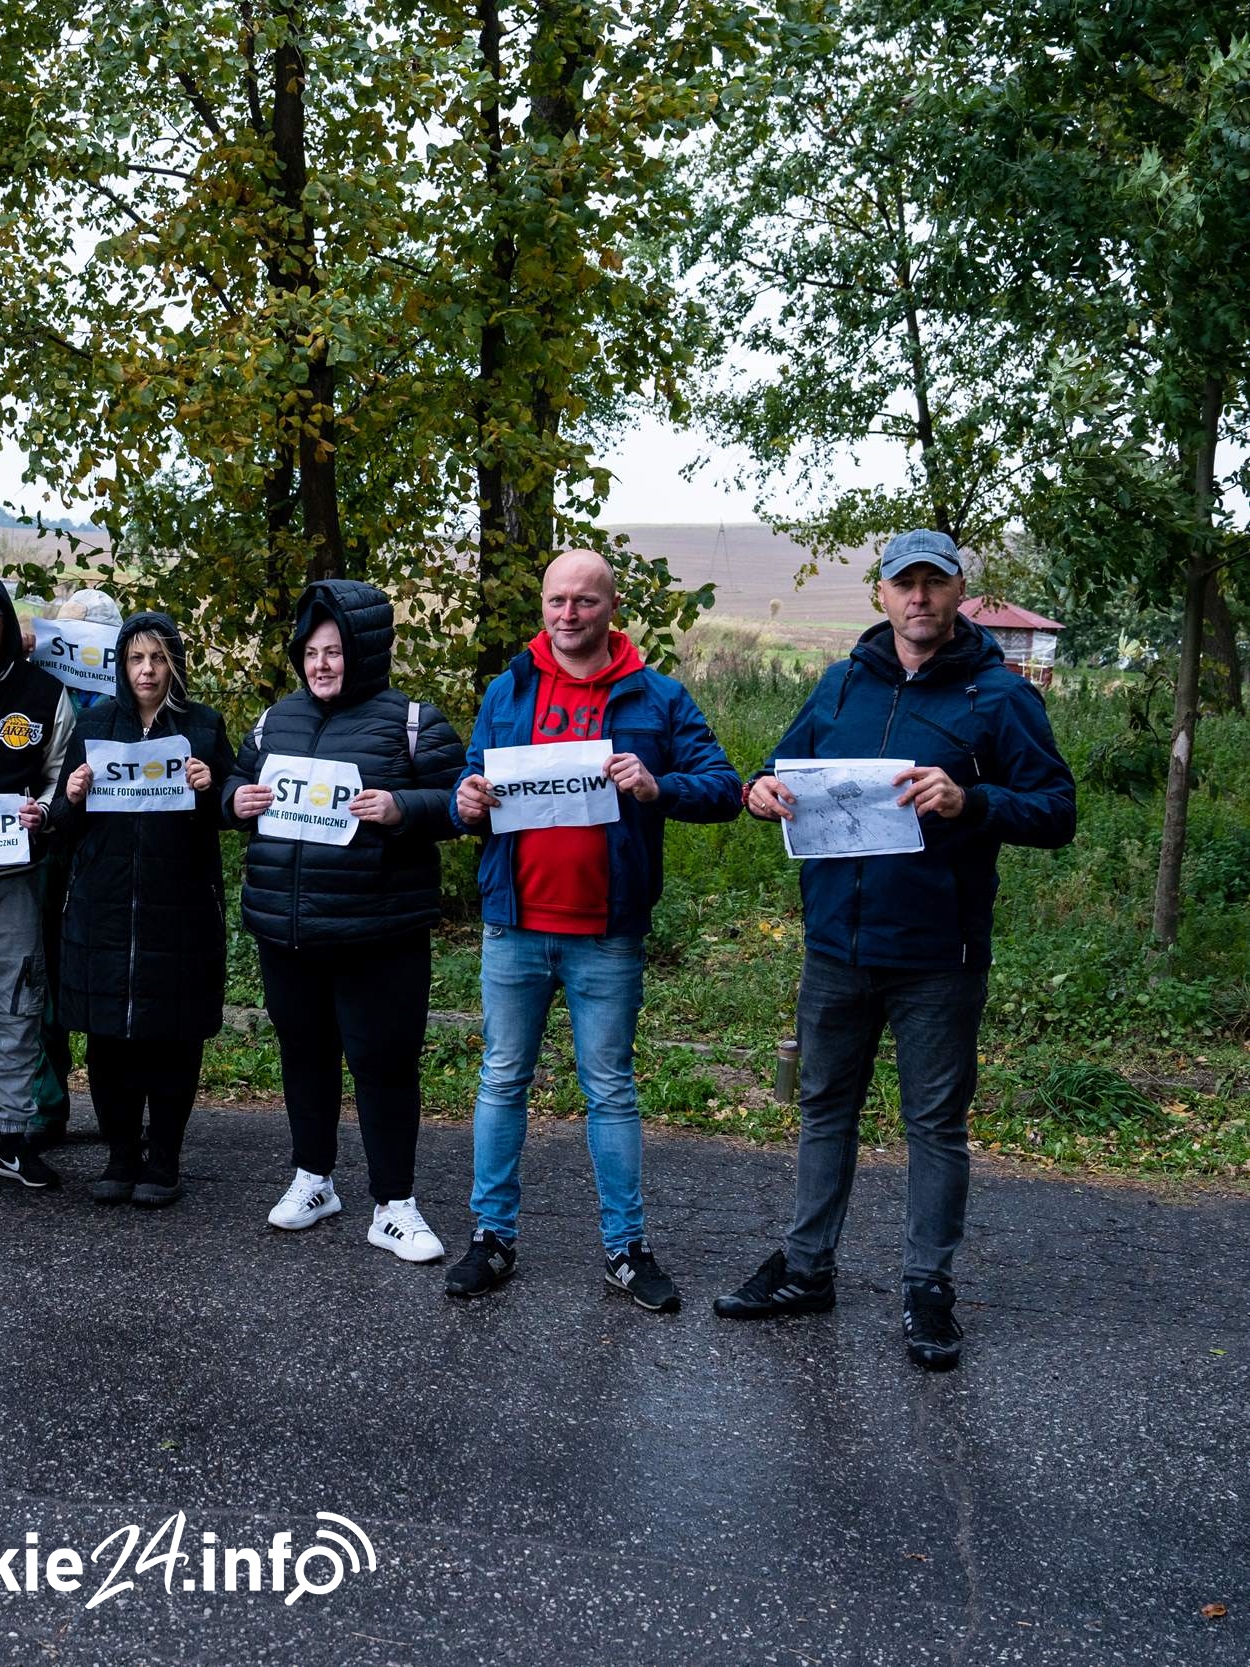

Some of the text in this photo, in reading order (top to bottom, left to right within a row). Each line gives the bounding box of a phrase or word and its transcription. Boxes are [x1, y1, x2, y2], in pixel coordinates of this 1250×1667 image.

[59, 663, 116, 683] FOTOWOLTAICZNE
[117, 786, 184, 797] FOTOWOLTAICZNEJ
[493, 775, 608, 797] SPRZECIW
[281, 811, 348, 829] FOTOWOLTAICZNEJ
[615, 1262, 636, 1287] N
